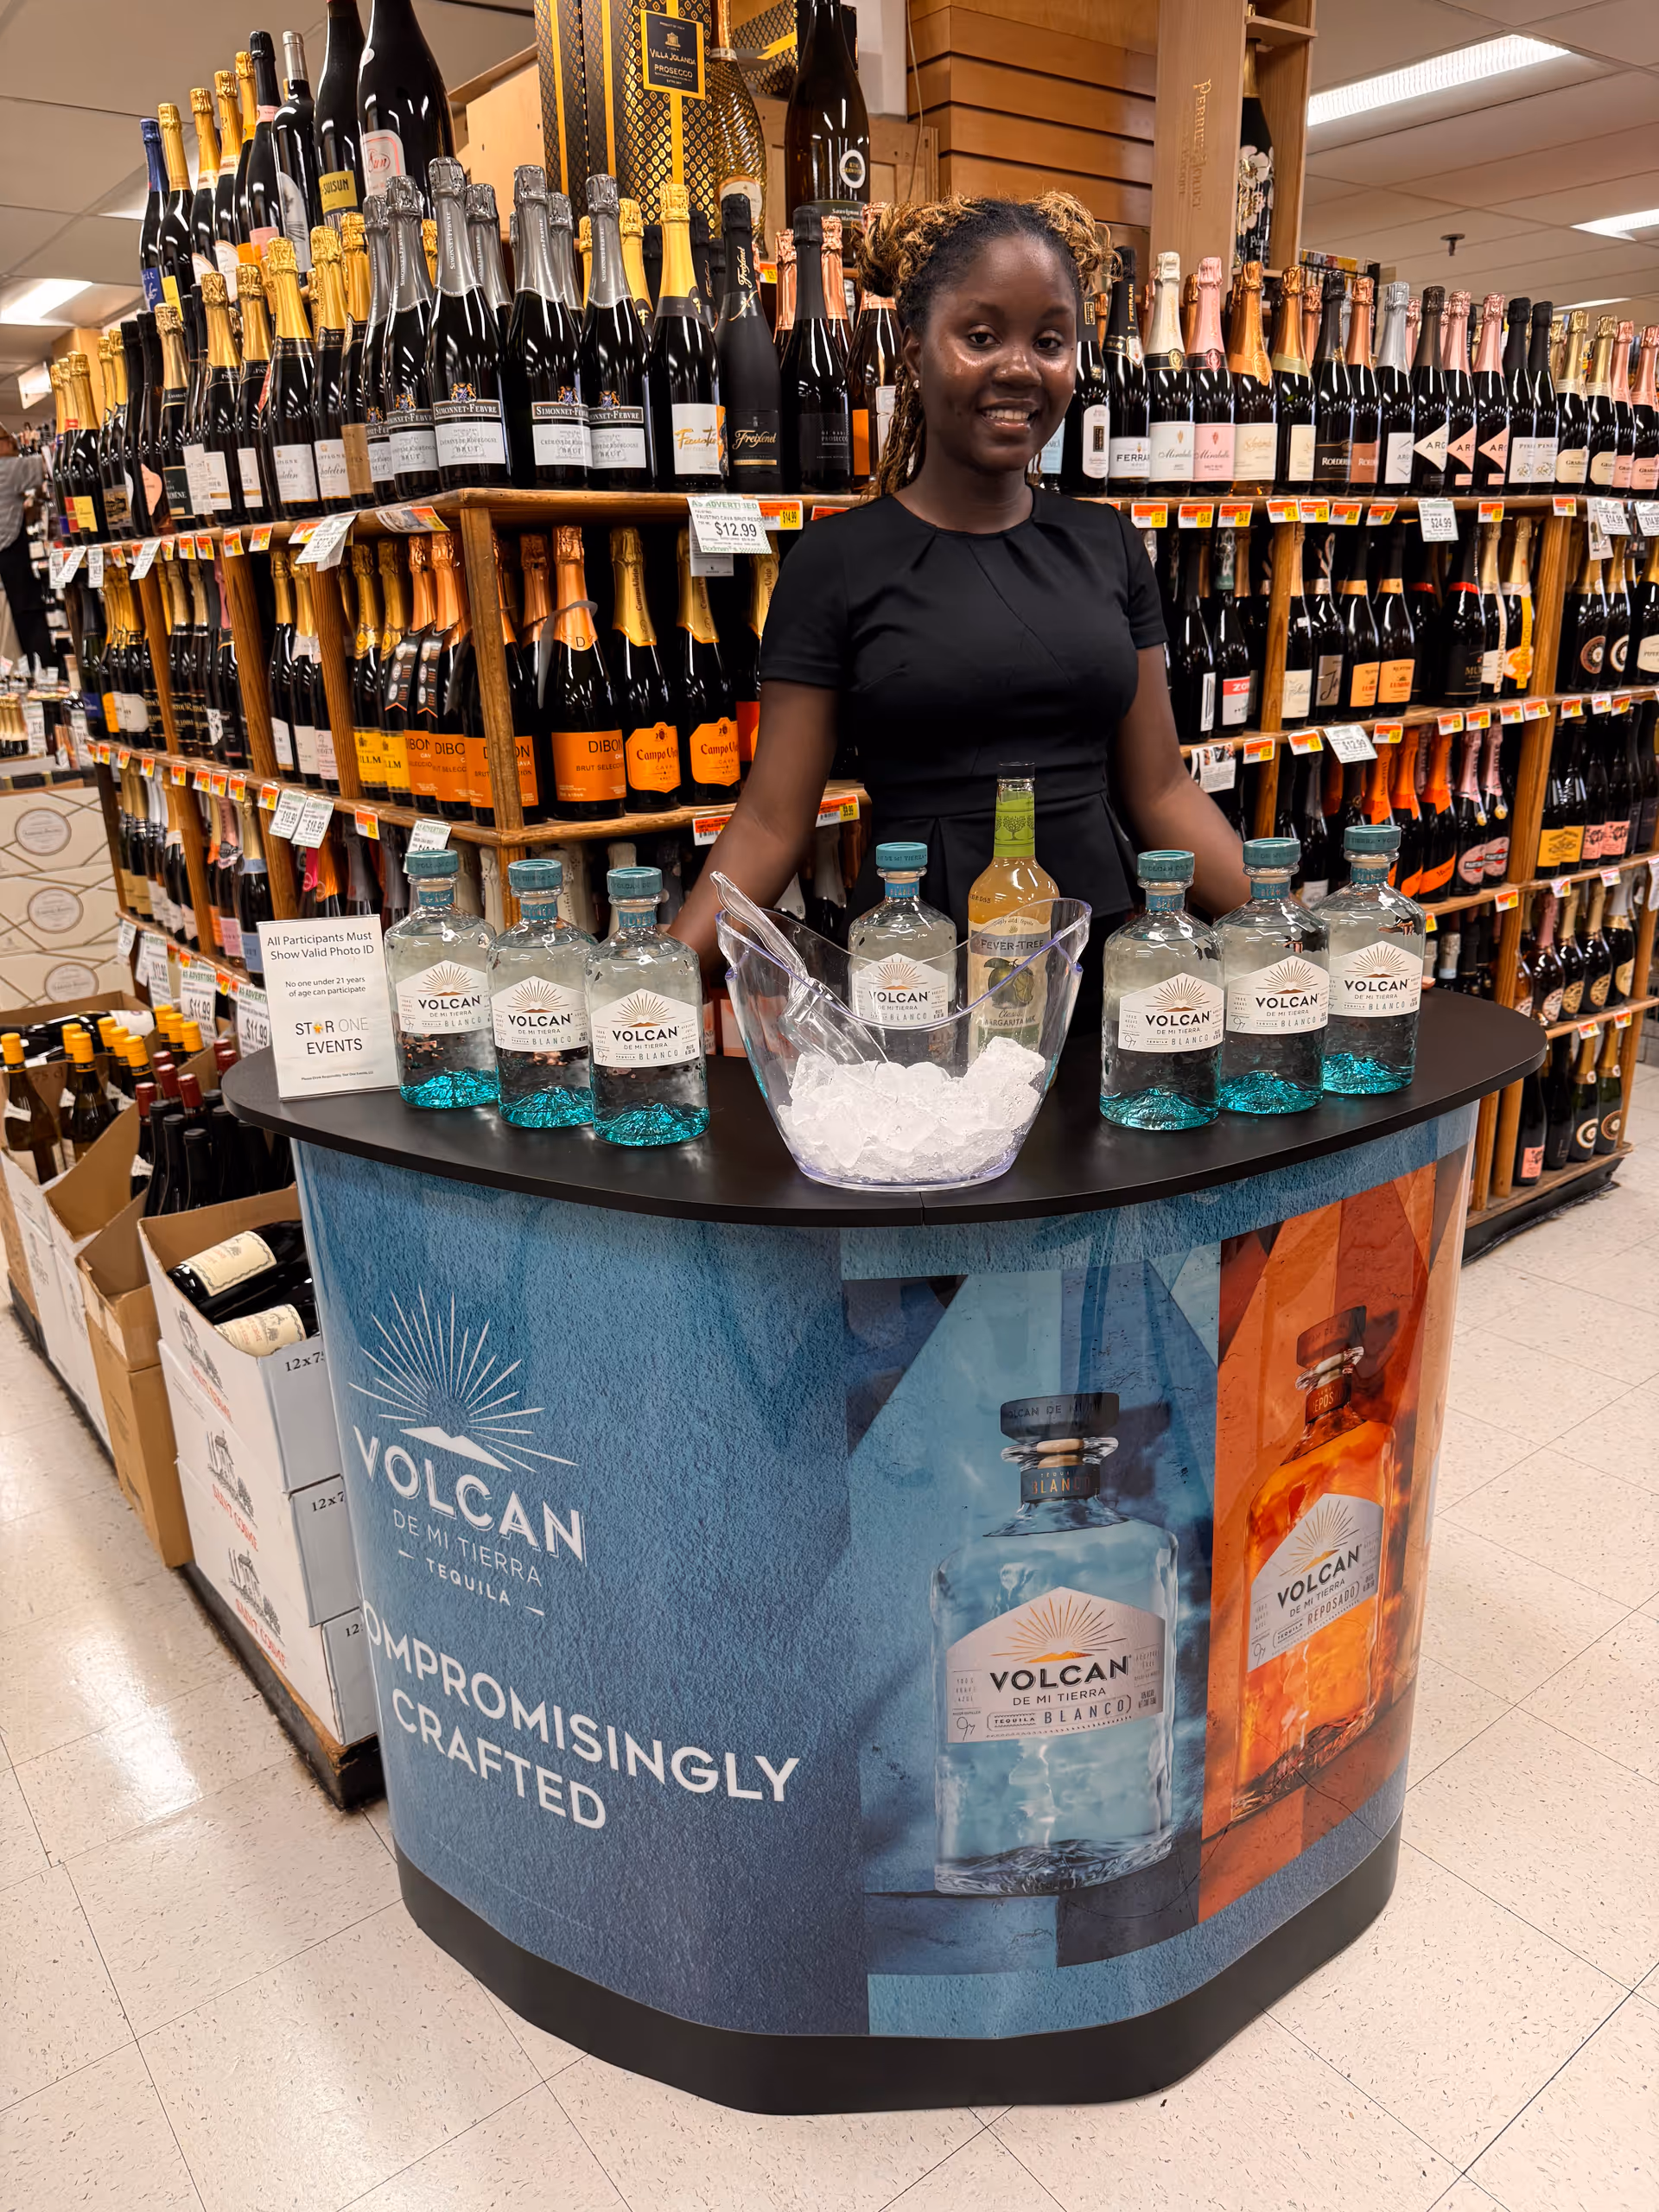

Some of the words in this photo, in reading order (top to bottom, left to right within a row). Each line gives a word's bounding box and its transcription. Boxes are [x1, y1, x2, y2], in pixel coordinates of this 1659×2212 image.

[650, 48, 669, 60] VILLA
[669, 52, 696, 66] JOLANDA
[654, 63, 693, 79] PROSECCO
[435, 404, 498, 416] SIMONNET-FEBVRE
[732, 429, 778, 451] Freixenet
[705, 499, 758, 510] ADVERTIED
[715, 521, 757, 537] $12.99
[1430, 518, 1452, 529] $24.99
[575, 636, 586, 648] D
[636, 747, 666, 763] Campo
[700, 742, 730, 757] Campo
[576, 763, 596, 772] BRUT
[267, 936, 282, 947] All
[283, 933, 345, 947] Participants
[346, 931, 372, 942] Must
[981, 939, 1044, 951] FEVER-TREE
[270, 950, 300, 961] Show
[302, 947, 327, 959] Valid
[329, 945, 361, 957] Photo
[363, 945, 374, 955] ID
[313, 978, 335, 987] under
[346, 976, 365, 986] years
[1344, 978, 1409, 993] VOLCAN
[289, 988, 297, 997] of
[297, 989, 312, 998] age
[313, 988, 327, 996] can
[327, 984, 366, 997] participate
[190, 997, 211, 1021] $11.99
[418, 995, 480, 1010] VOLCAN
[1255, 993, 1319, 1009] VOLCAN
[1368, 1001, 1406, 1011] BLANCO
[508, 1013, 571, 1027] VOLCAN
[1145, 1010, 1210, 1027] VOLCAN
[1287, 1007, 1309, 1017] TIERRA
[338, 1017, 370, 1033] ONE
[445, 1016, 482, 1027] BLANCO
[1281, 1015, 1317, 1028] BLANCO
[246, 1018, 268, 1047] $11.99
[613, 1027, 678, 1042] VOLCAN
[1178, 1026, 1200, 1035] TIERRA
[306, 1038, 363, 1056] EVENTS
[532, 1035, 572, 1046] BLANCO
[644, 1041, 668, 1050] TIERRA
[1171, 1033, 1209, 1046] BLANCO
[639, 1048, 678, 1061] BLANCO
[353, 1425, 588, 1567] VOLCAN
[393, 1507, 421, 1537] DE
[426, 1521, 450, 1552] MI
[458, 1535, 543, 1588] TIERRA
[426, 1556, 512, 1608] TEQUILA
[1276, 1543, 1360, 1610] VOLCAN
[1289, 1605, 1303, 1618] DE
[1304, 1598, 1314, 1611] MI
[1316, 1577, 1346, 1605] TIERRA
[1277, 1619, 1304, 1642] TEQUILA
[1306, 1585, 1357, 1627] REPOSADO
[989, 1656, 1128, 1693] VOLCAN
[1013, 1695, 1032, 1707] DE
[1036, 1692, 1053, 1704] MI
[1057, 1687, 1107, 1702] TIERRA
[1044, 1699, 1125, 1725] BLANCO
[391, 1688, 607, 1831] CRAFTED
